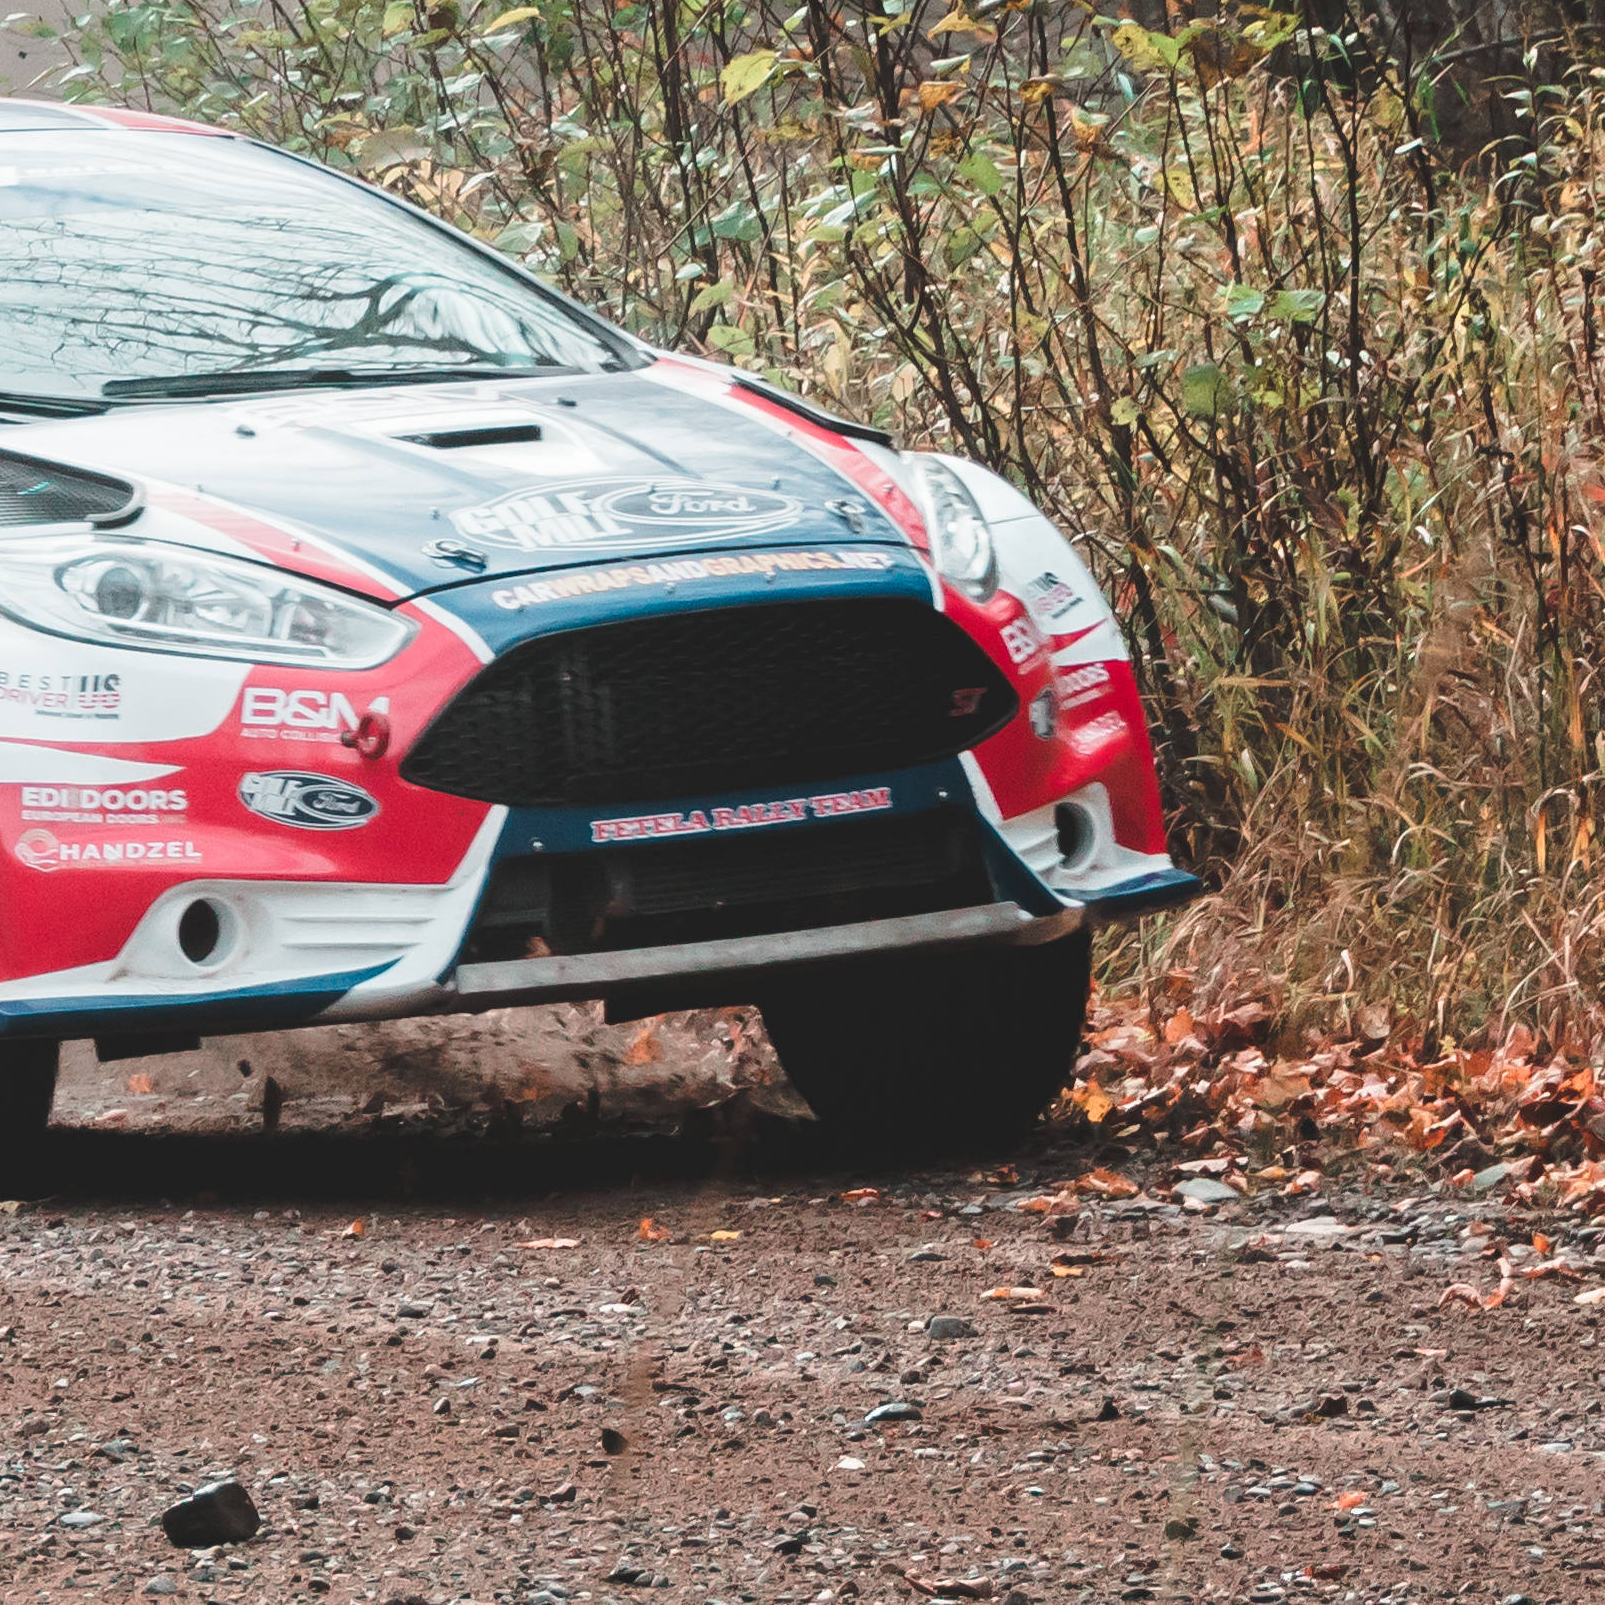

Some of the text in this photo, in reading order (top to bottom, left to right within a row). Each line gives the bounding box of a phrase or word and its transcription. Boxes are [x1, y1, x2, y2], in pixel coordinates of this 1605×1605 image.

[461, 491, 601, 535] GOLF
[648, 491, 756, 515] Ford
[79, 788, 188, 811] DOORS
[591, 787, 893, 842] FETELA RALLY TEAM
[59, 841, 203, 860] HANDZEL
